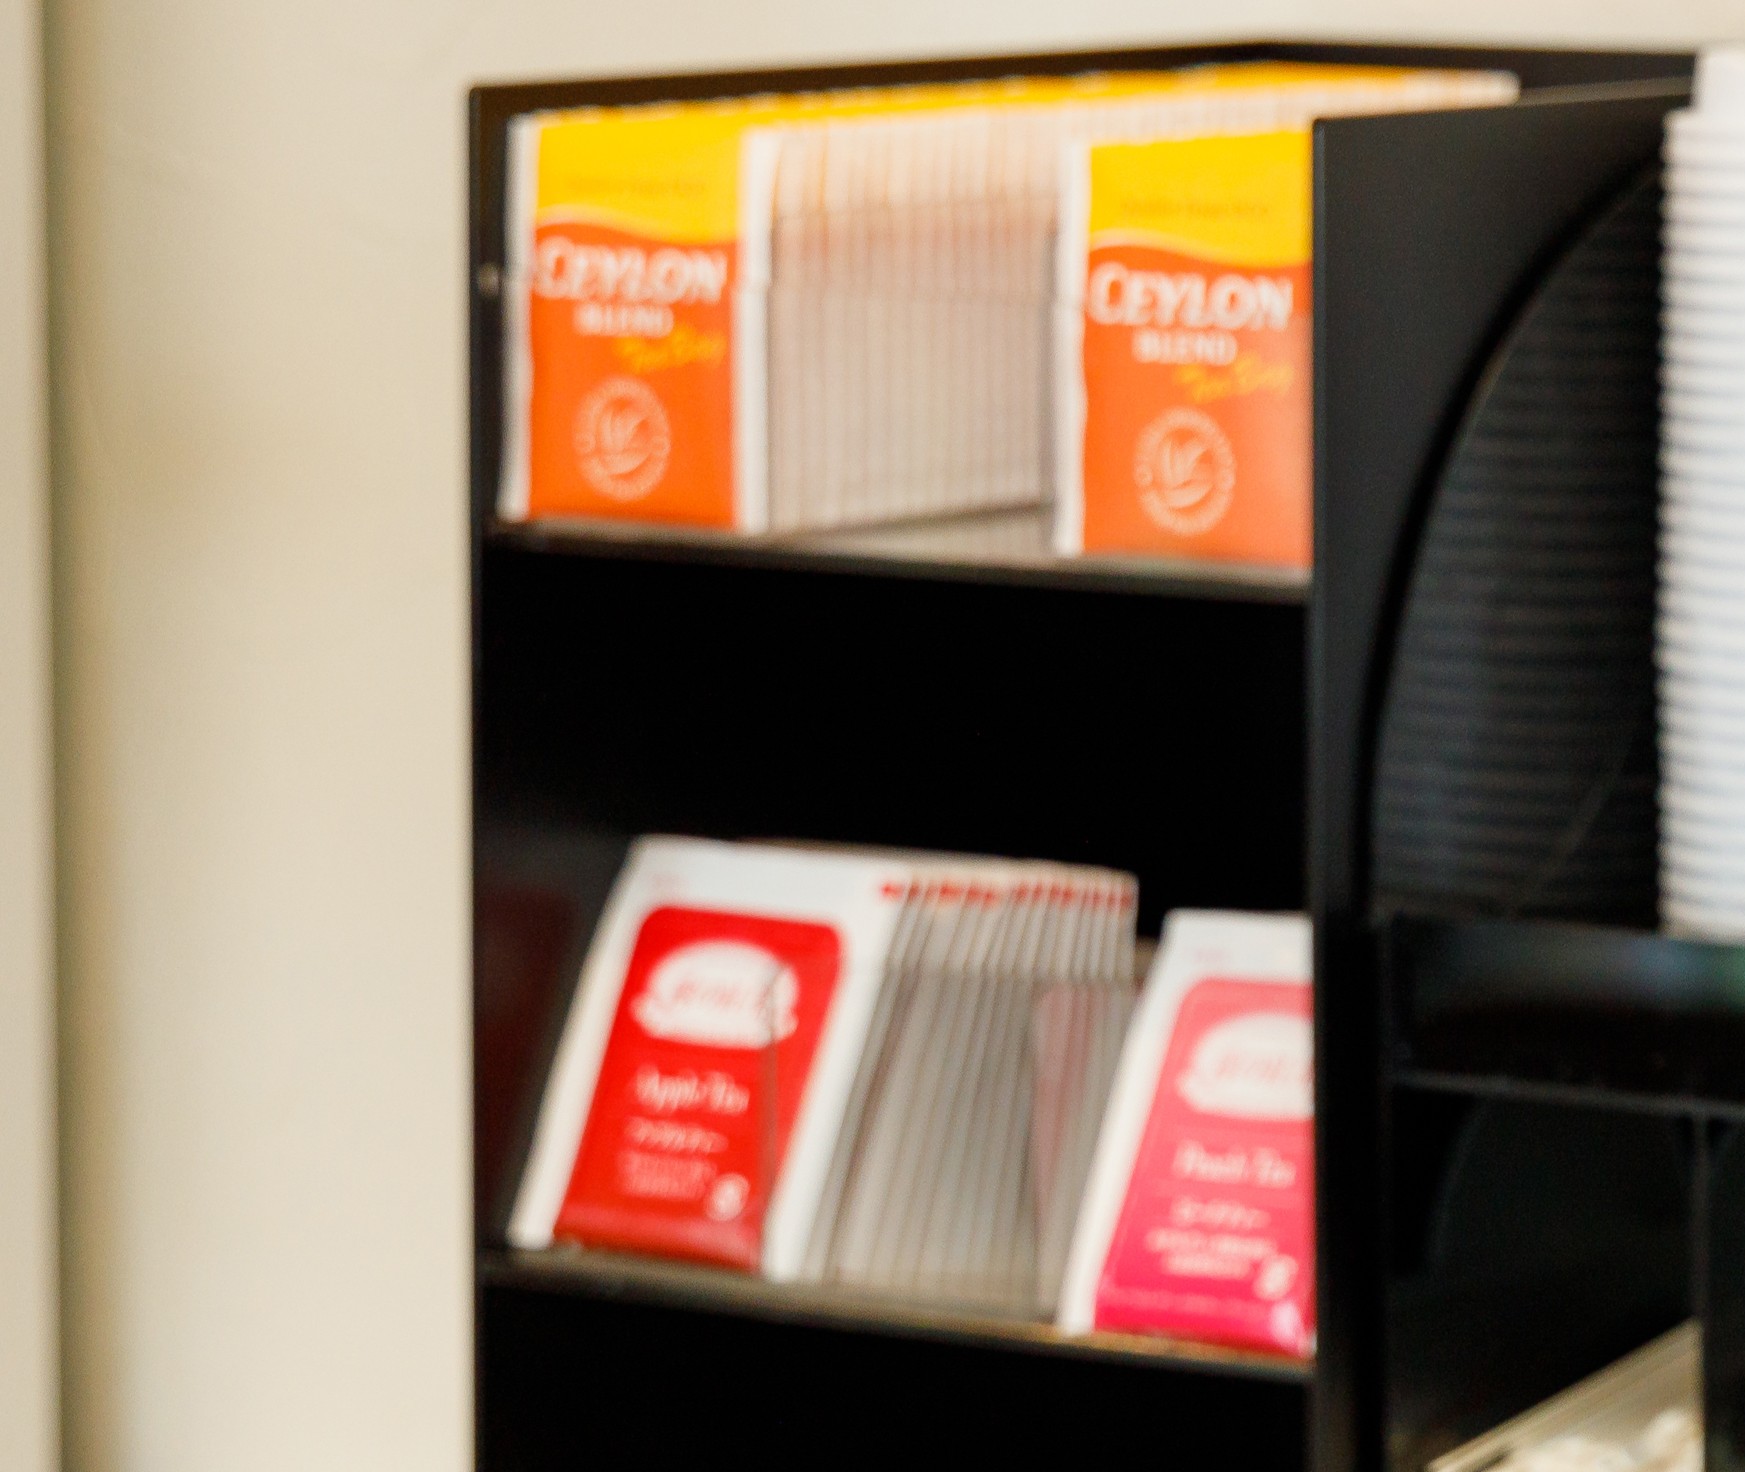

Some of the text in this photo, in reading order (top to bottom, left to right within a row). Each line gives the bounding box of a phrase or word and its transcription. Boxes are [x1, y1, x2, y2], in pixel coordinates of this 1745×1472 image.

[535, 236, 728, 306] CEYLON
[1088, 261, 1294, 332] CEYLON
[572, 302, 675, 338] BLEND
[1132, 328, 1238, 366] BLEND
